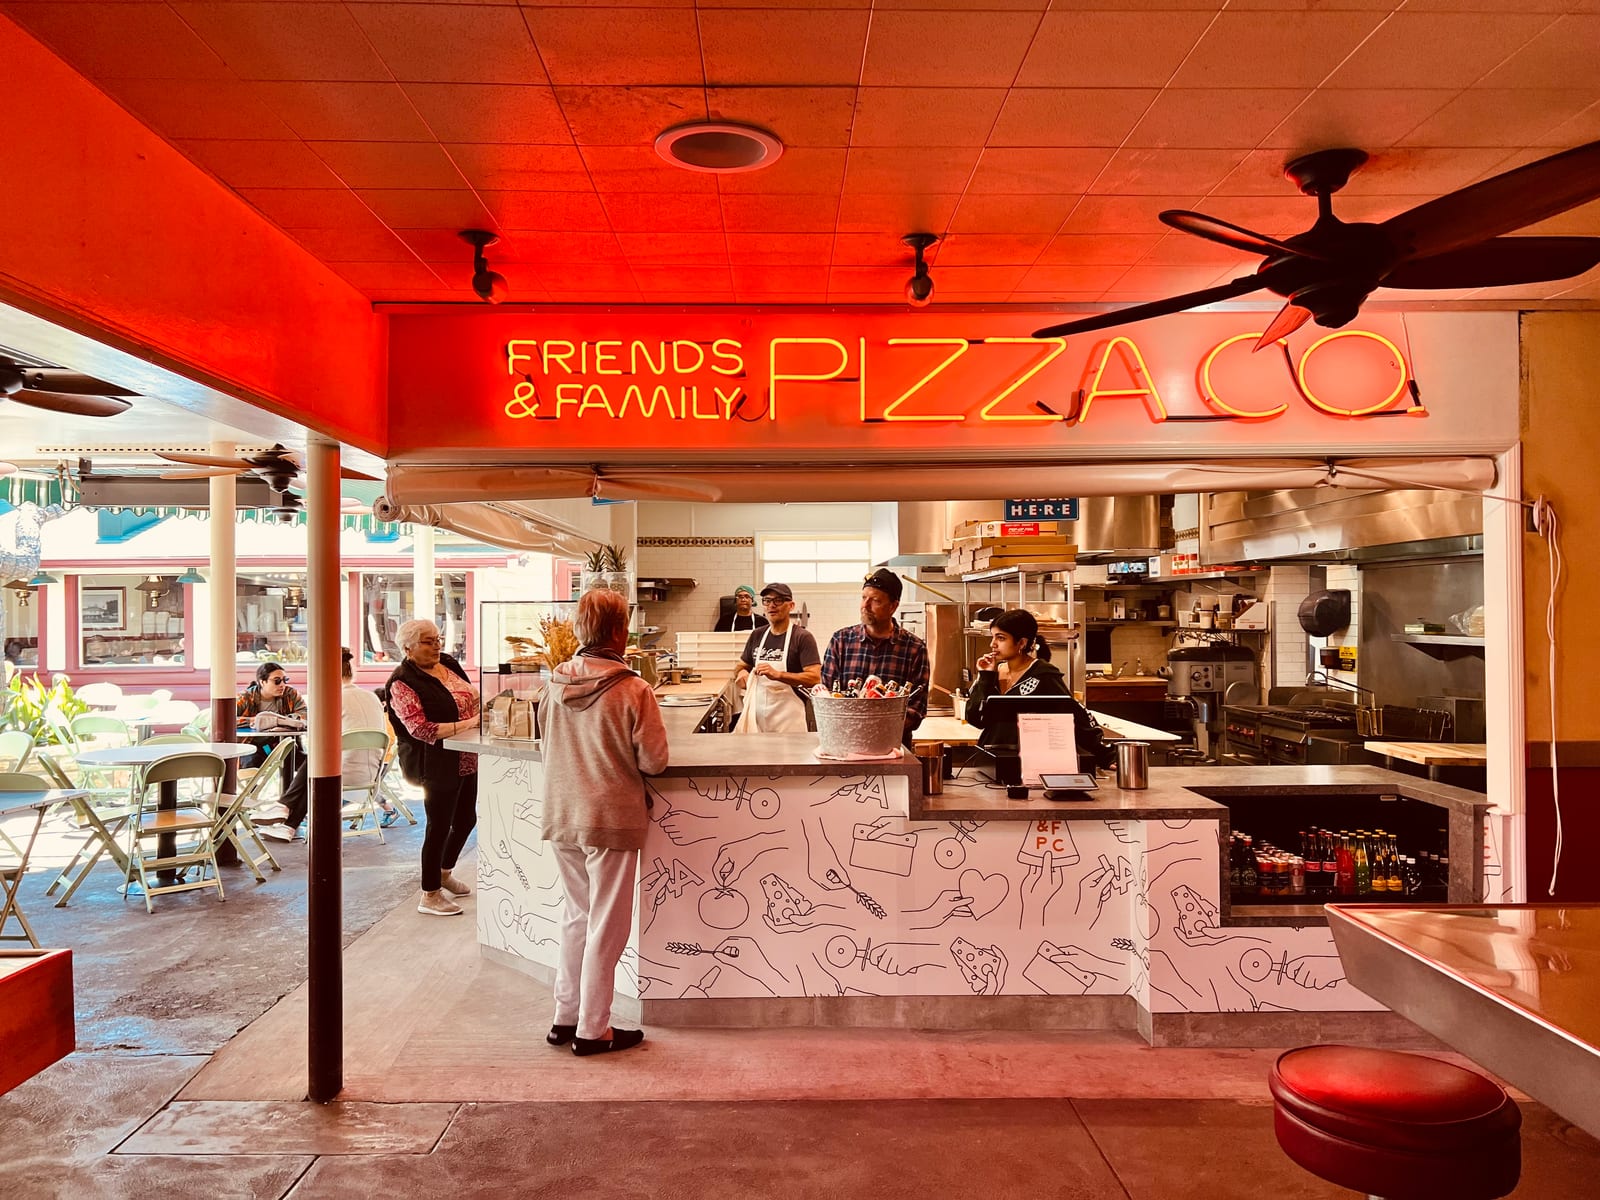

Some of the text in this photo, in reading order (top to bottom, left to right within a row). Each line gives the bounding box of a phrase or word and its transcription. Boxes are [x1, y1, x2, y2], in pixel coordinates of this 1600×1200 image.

[507, 339, 743, 375] FRIENDS
[769, 330, 1407, 422] PIZZA CO
[505, 382, 742, 420] & FAMILY
